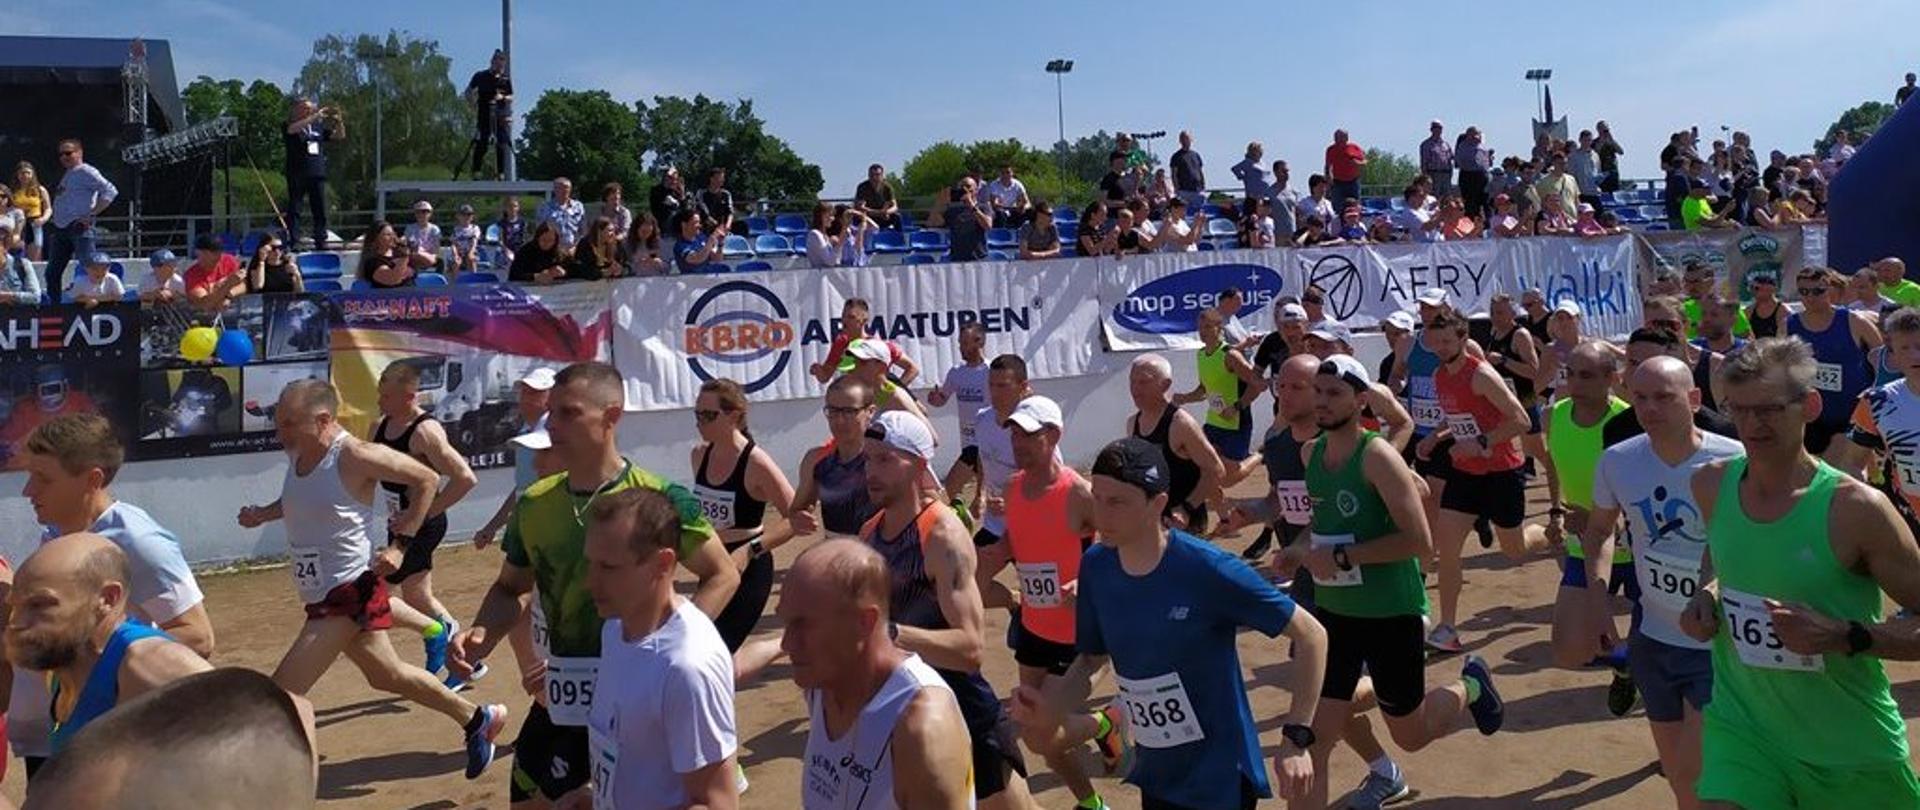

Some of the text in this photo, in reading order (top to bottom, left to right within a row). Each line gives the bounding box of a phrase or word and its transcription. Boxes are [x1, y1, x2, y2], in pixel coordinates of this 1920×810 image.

[1381, 263, 1486, 302] AFRY
[1183, 289, 1272, 315] seris
[1283, 495, 1312, 512] 119
[1024, 577, 1055, 596] 190
[1648, 567, 1697, 598] 190
[550, 679, 593, 705] 095
[1125, 698, 1186, 728] 1368
